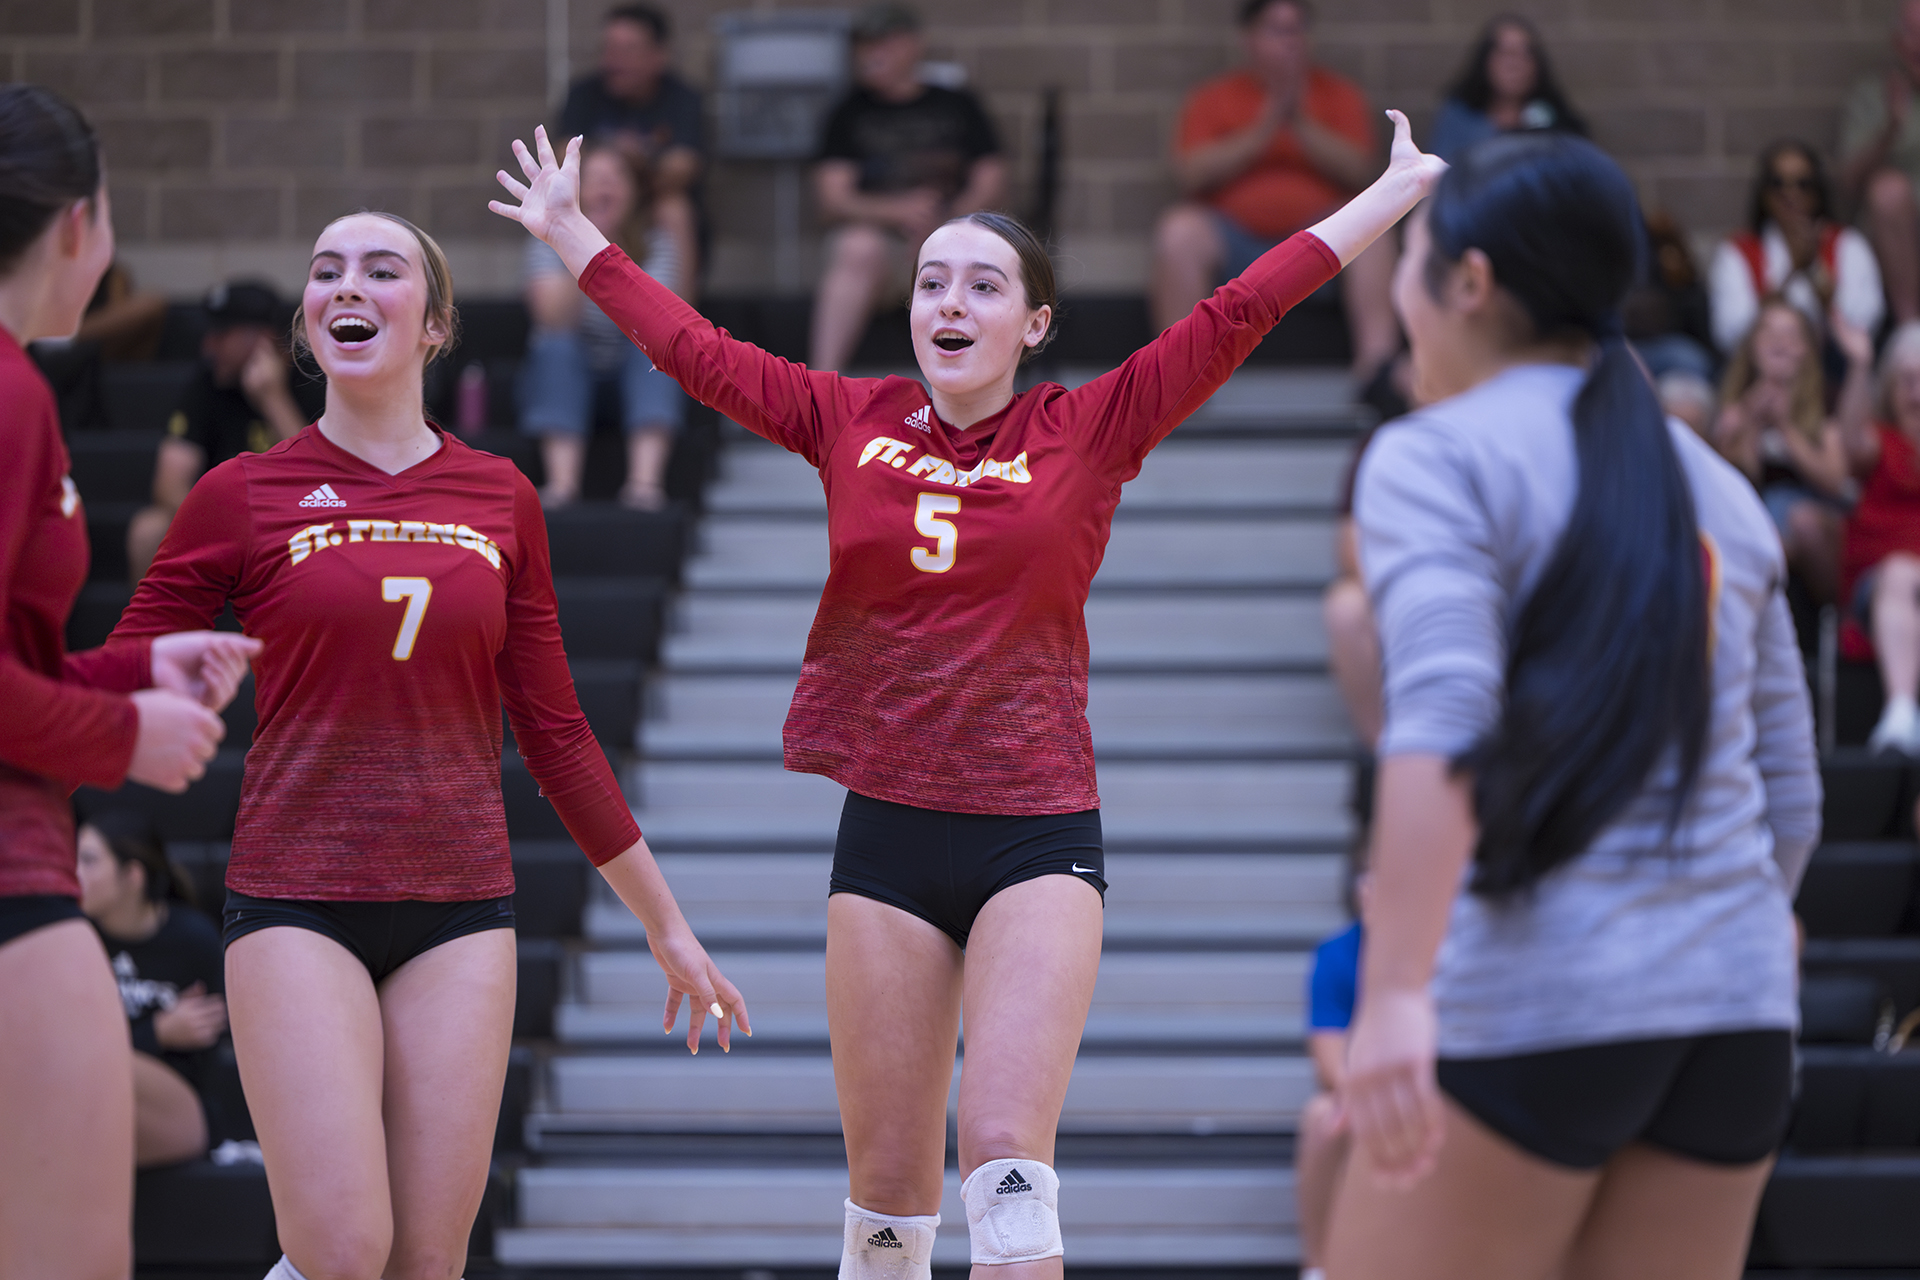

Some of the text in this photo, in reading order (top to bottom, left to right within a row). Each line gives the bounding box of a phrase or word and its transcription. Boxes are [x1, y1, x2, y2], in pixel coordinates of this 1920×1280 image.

[904, 416, 931, 434] adidas
[857, 436, 1032, 487] ST. FRCIS
[298, 498, 347, 508] adidas
[288, 522, 344, 567] ST.
[910, 491, 962, 574] 5
[381, 576, 434, 661] 7
[996, 1182, 1033, 1195] adidas
[867, 1236, 903, 1249] adidas
